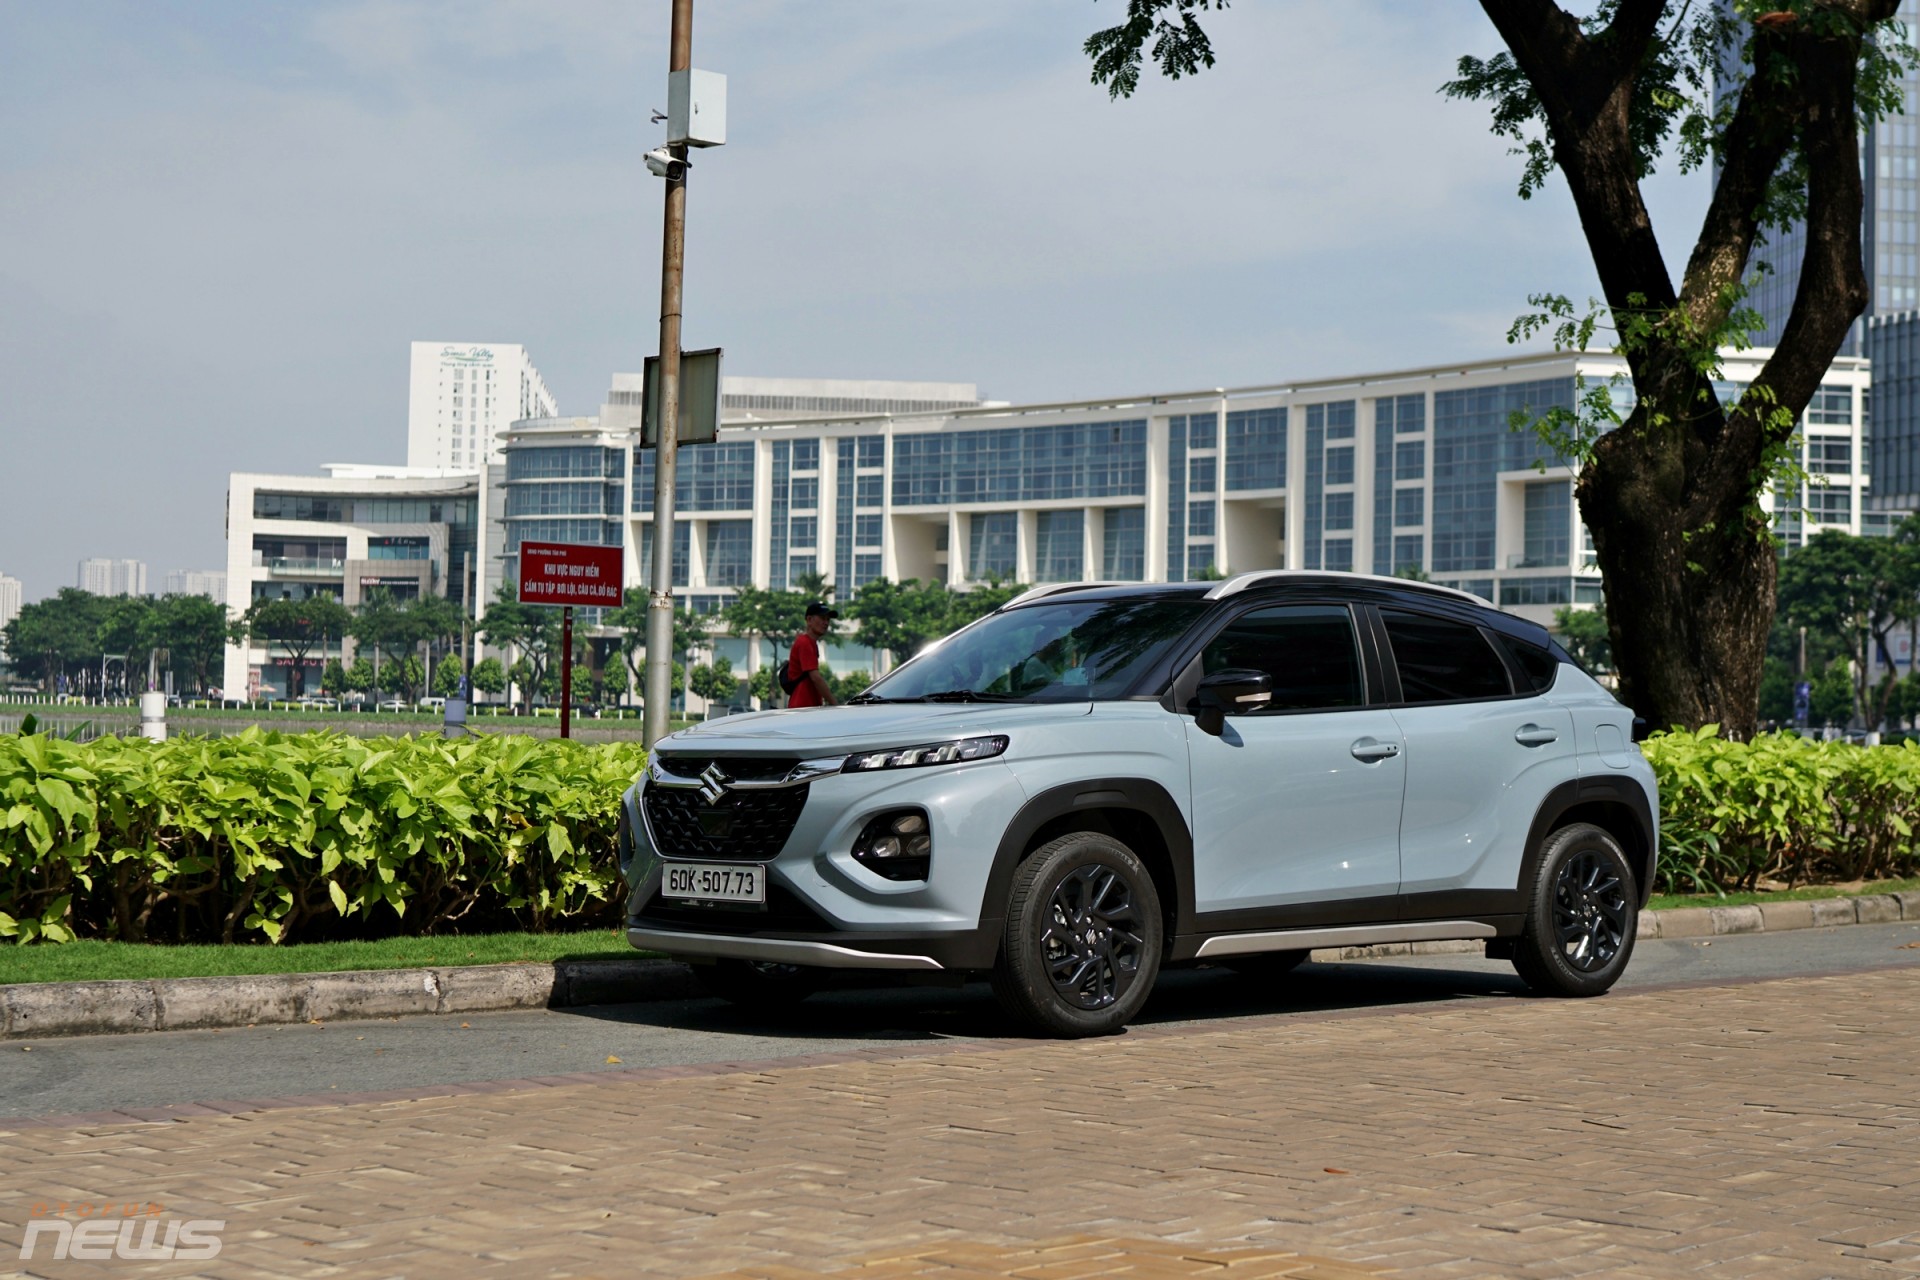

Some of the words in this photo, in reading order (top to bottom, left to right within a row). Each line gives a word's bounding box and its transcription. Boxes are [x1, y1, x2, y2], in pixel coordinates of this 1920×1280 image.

[544, 563, 556, 574] KHU
[557, 563, 569, 577] VỰC
[569, 565, 584, 577] NGUY
[585, 562, 599, 577] HIỂM
[525, 579, 536, 592] CẤM
[538, 583, 544, 595] TỤ
[545, 581, 556, 595] TẬP
[557, 583, 566, 594] BƠI
[578, 583, 589, 596] CÂU
[607, 585, 618, 598] RÁC
[670, 869, 754, 894] 60K-507.73
